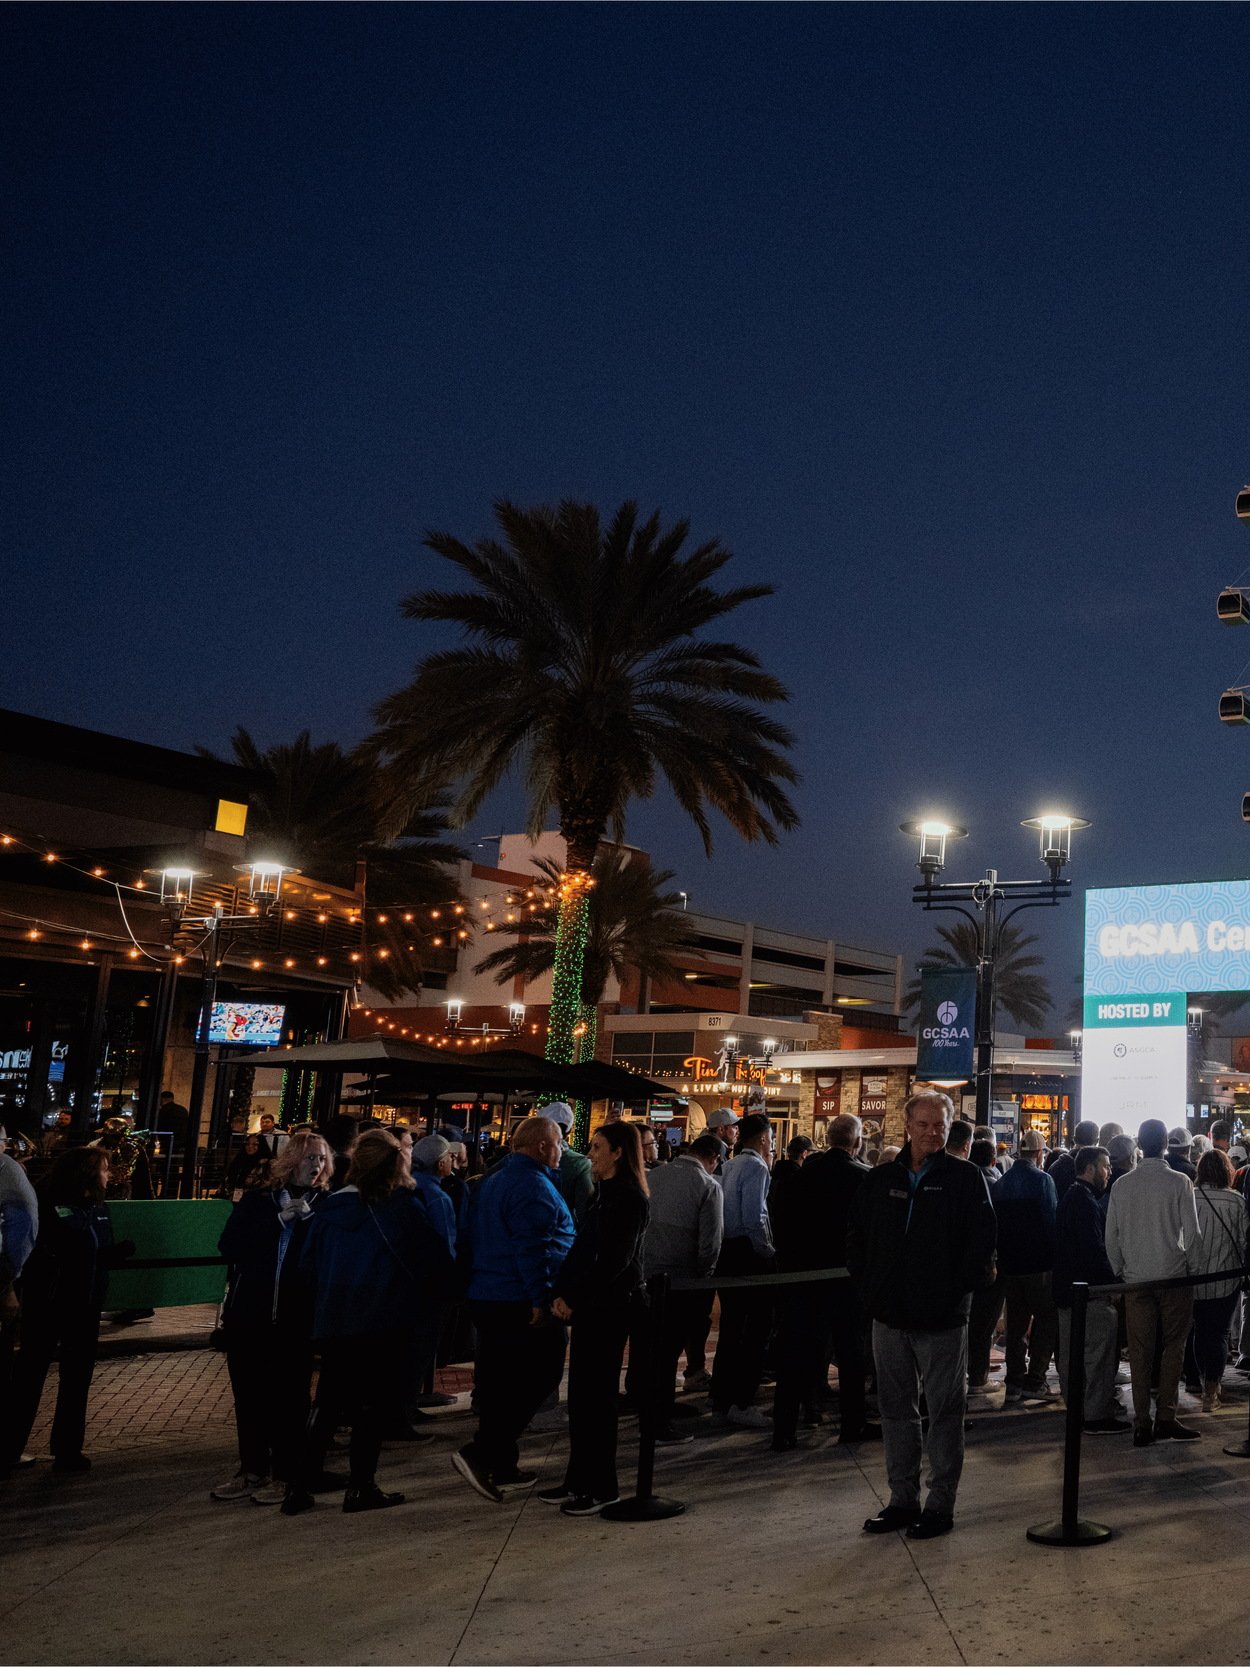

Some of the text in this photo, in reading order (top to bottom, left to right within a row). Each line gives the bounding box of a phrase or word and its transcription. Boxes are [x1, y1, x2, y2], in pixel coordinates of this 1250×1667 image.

[1100, 922, 1200, 957] GCSAA
[1098, 1002, 1172, 1019] HOSTED BY
[708, 1016, 722, 1027] 8371
[922, 1027, 970, 1039] GCSAA
[932, 1039, 945, 1048] 100
[683, 1056, 719, 1082] Tin
[682, 1084, 689, 1093] A
[693, 1084, 719, 1093] LIVE
[822, 1101, 835, 1111] SIP
[861, 1100, 886, 1111] SAVOR
